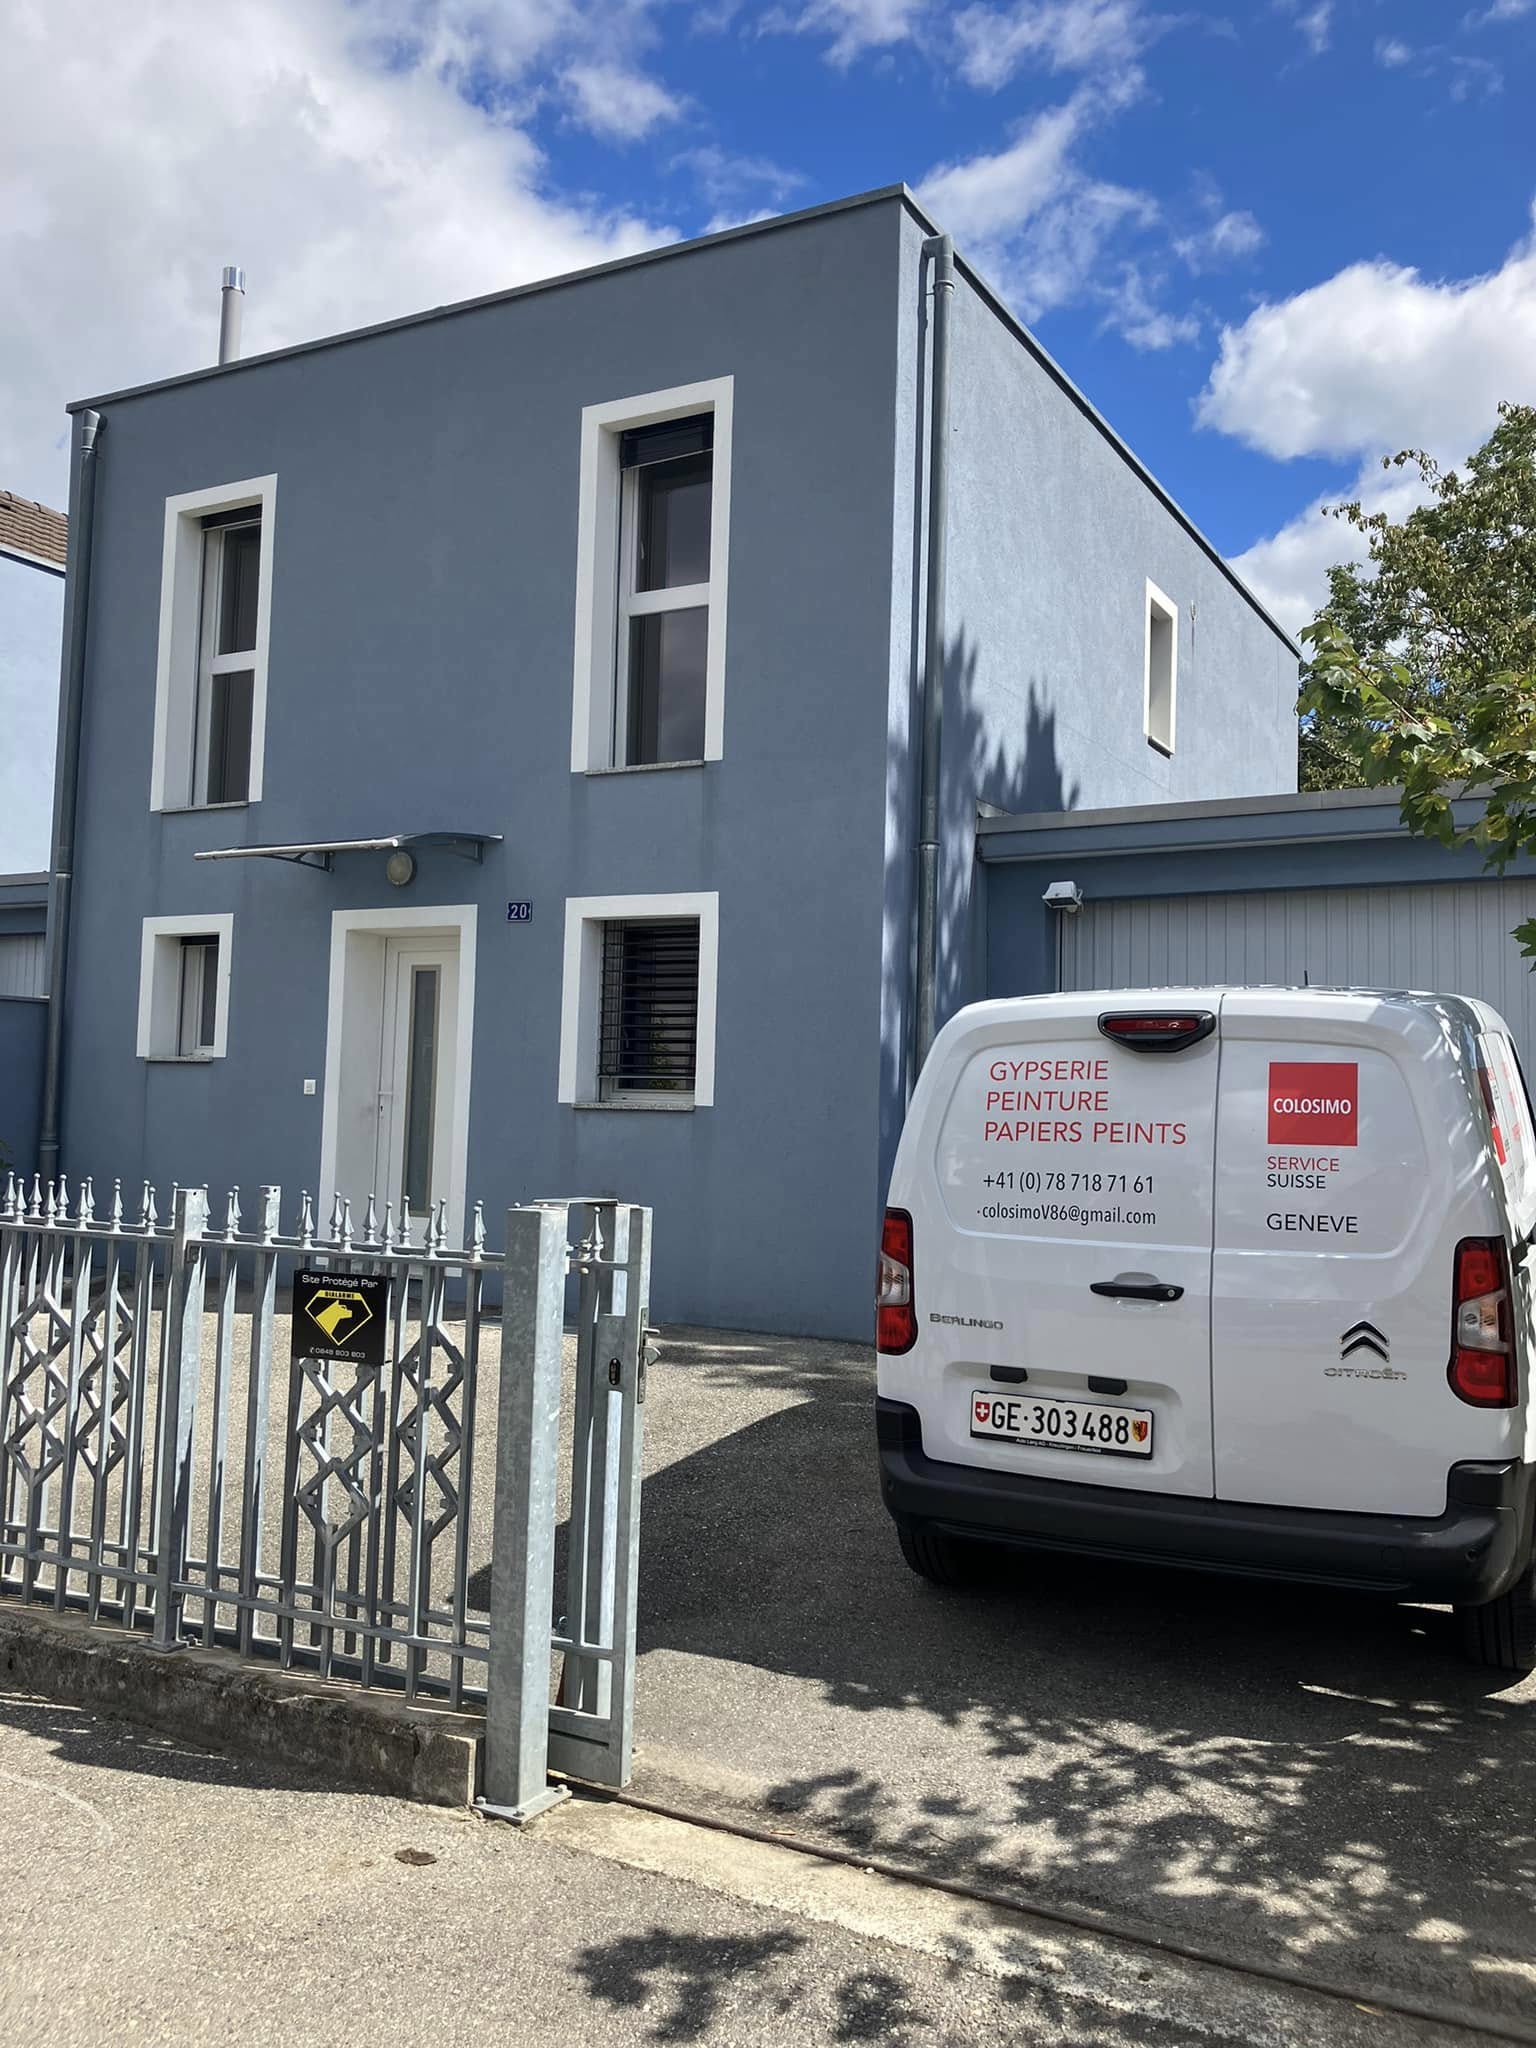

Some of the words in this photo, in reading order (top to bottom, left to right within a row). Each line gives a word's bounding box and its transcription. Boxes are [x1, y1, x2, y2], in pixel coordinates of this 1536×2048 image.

[510, 903, 527, 919] 20
[989, 1060, 1110, 1081] GYPSERIE
[986, 1090, 1110, 1112] PEINTURE
[1272, 1097, 1352, 1115] COLOSIMO
[983, 1121, 1083, 1143] PAPIERS
[1093, 1122, 1187, 1145] PEINTS
[1266, 1155, 1340, 1172] SERVICE
[983, 1171, 1014, 1189] +41
[1019, 1171, 1041, 1193] (0)
[1046, 1172, 1066, 1191] 78
[1071, 1173, 1102, 1193] 718
[1107, 1174, 1127, 1193] 71
[1133, 1175, 1154, 1194] 61
[1266, 1173, 1327, 1189] SUISSE
[982, 1202, 1157, 1226] colosimoV86@gmail.com
[1266, 1212, 1359, 1234] GENEVE
[322, 1276, 359, 1288] Protégé
[361, 1278, 378, 1288] Par
[929, 1312, 1004, 1330] BERLINGO
